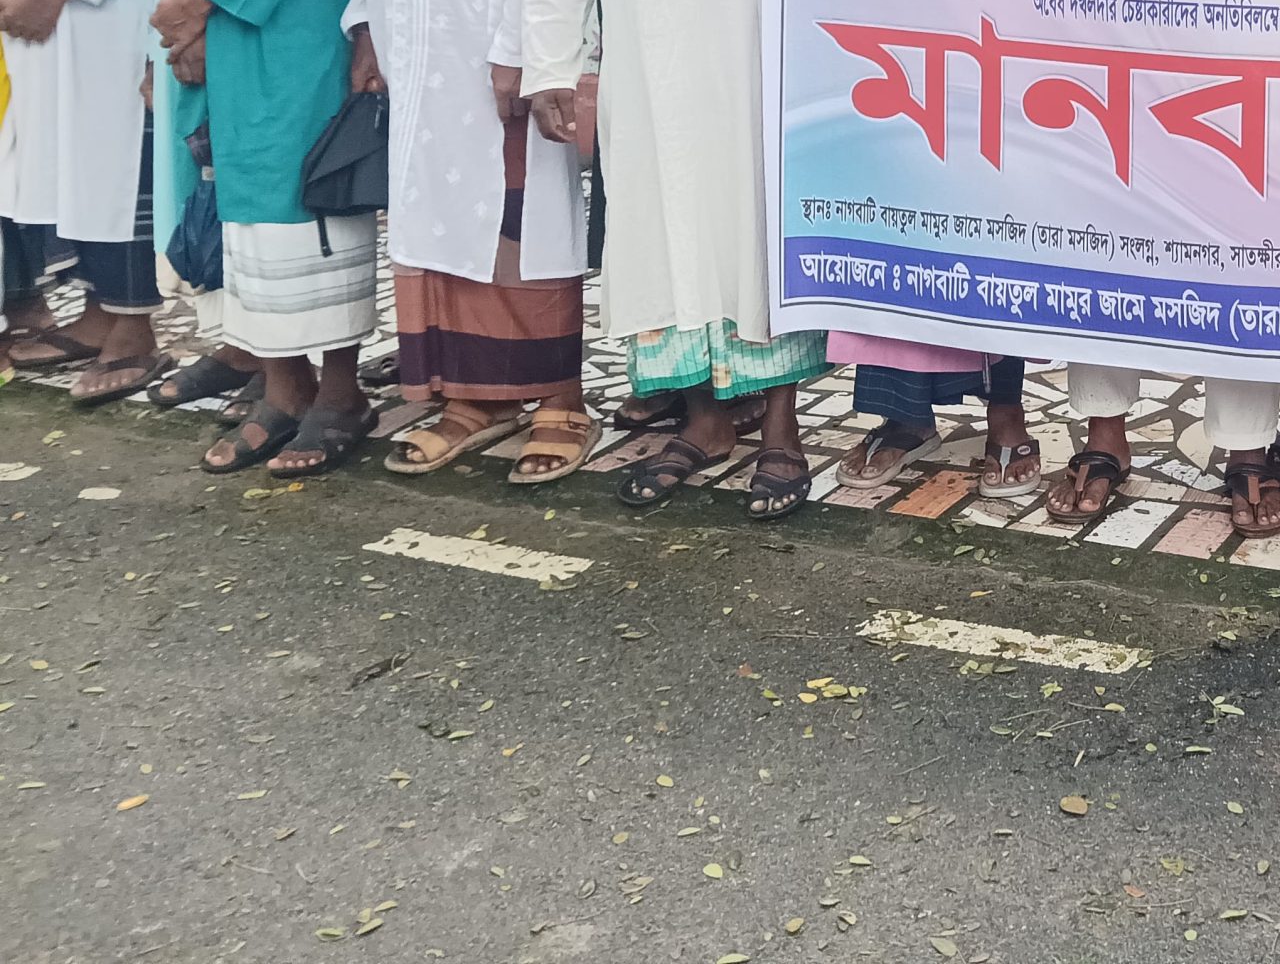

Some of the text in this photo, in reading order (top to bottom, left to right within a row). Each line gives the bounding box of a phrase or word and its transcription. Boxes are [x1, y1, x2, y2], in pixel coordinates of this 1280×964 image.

[835, 197, 876, 225] নাগবাটি
[881, 203, 916, 237] বায়তুল
[921, 211, 948, 239] মামুর
[953, 214, 982, 239] জামে
[987, 214, 1026, 244] মসজিদ
[1031, 222, 1063, 251] (তারা
[1068, 225, 1116, 261] মসজিদ)
[1119, 235, 1159, 266] সংলগ্ন,
[1164, 239, 1225, 272] শ্যামনগর,
[799, 251, 887, 290] আয়োজনে
[905, 262, 971, 301] নাগবাটি
[975, 273, 1040, 318] বায়তুল
[1045, 283, 1092, 324] মামুর
[1098, 288, 1145, 323] জামে
[1151, 289, 1222, 331] মসজিদ
